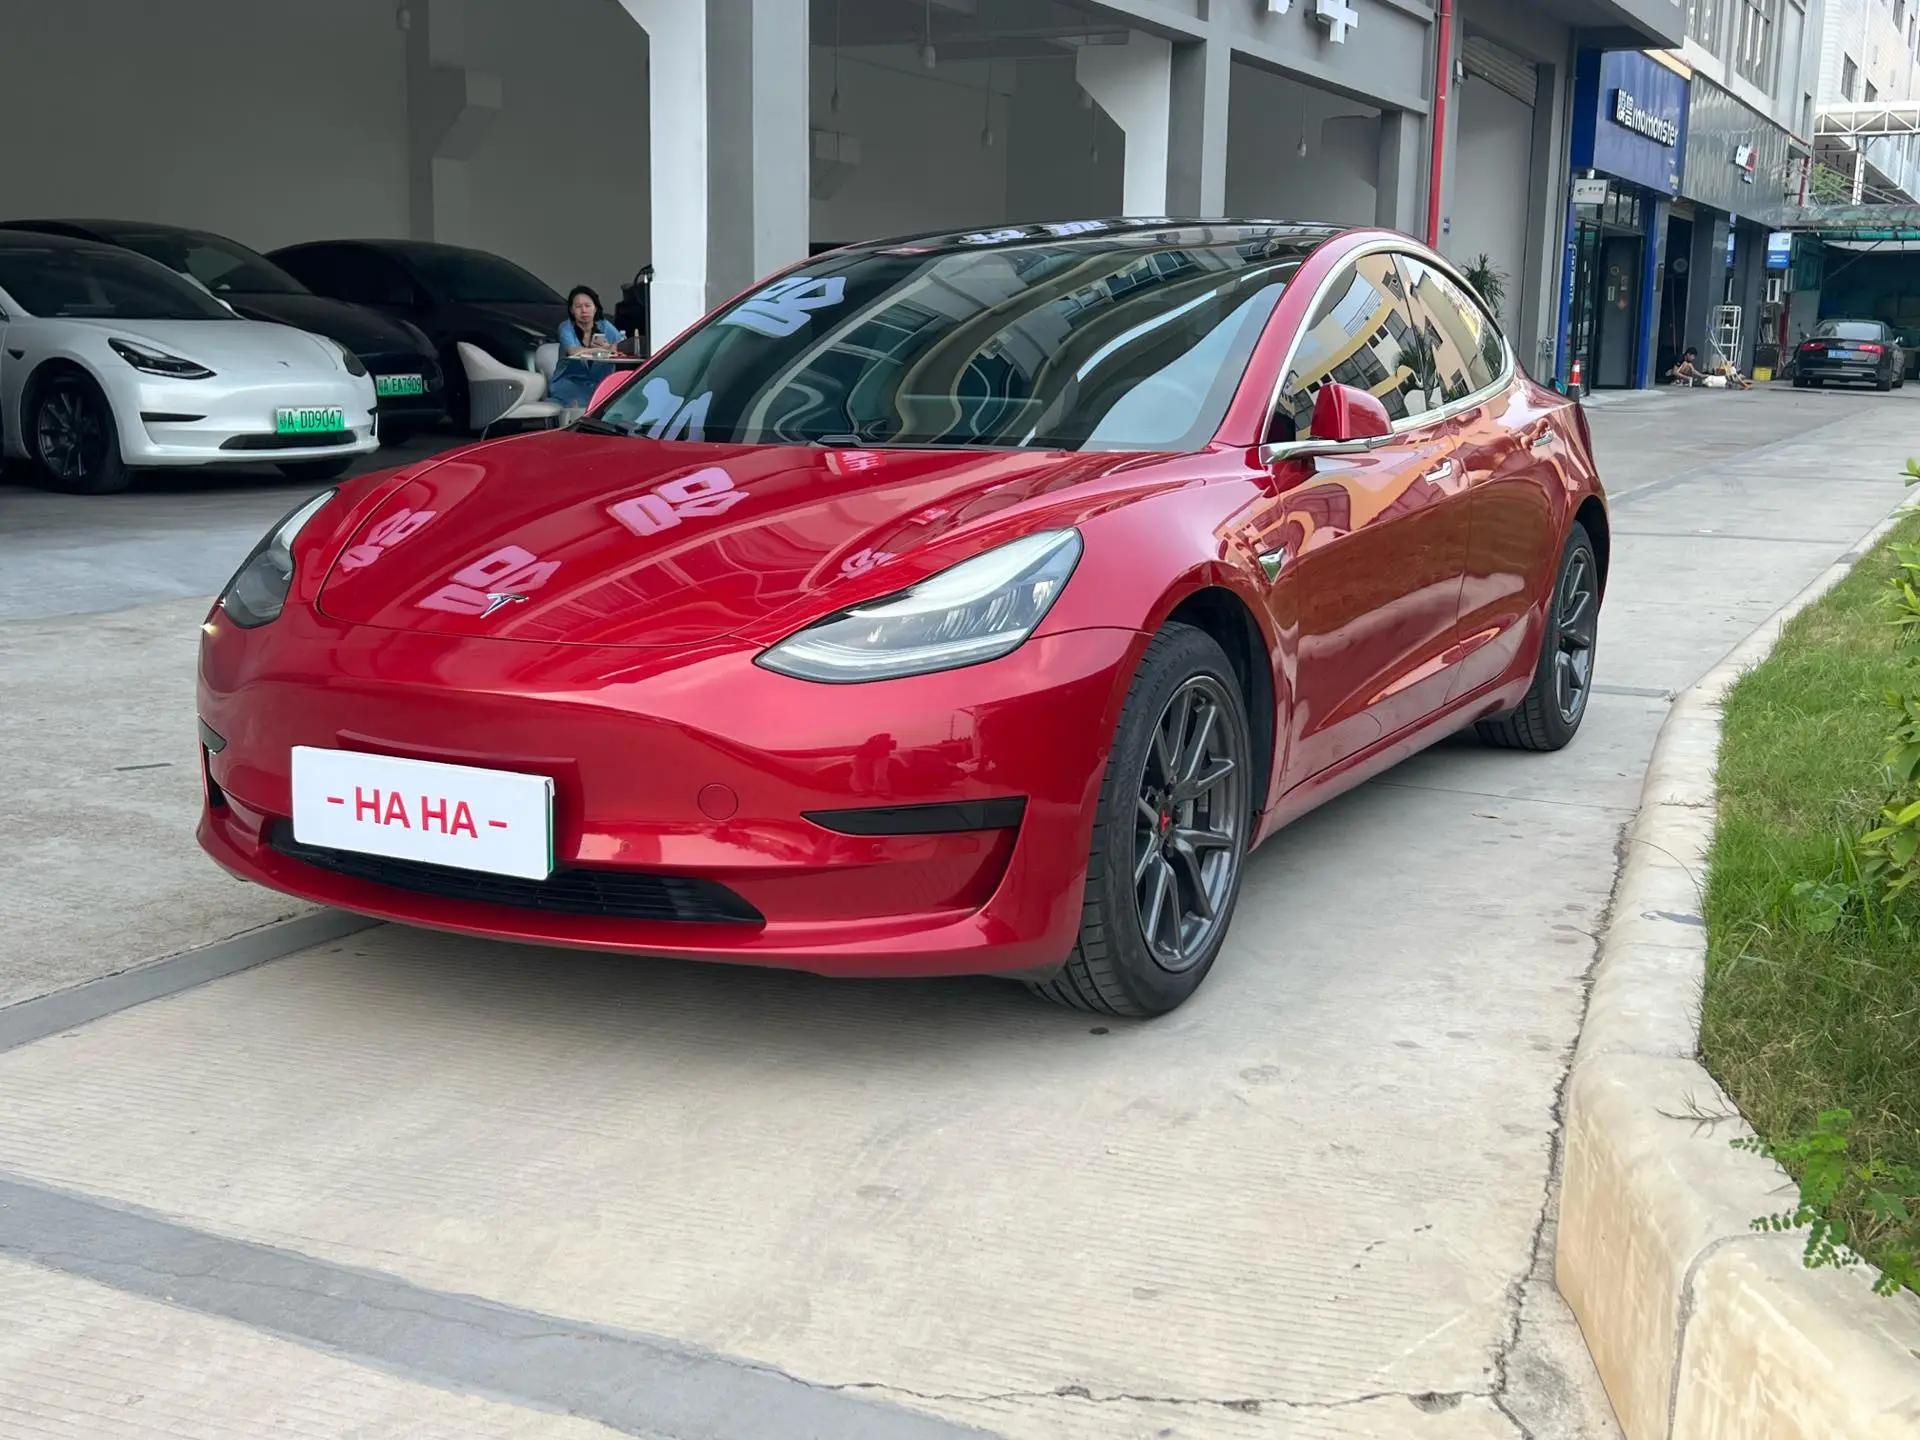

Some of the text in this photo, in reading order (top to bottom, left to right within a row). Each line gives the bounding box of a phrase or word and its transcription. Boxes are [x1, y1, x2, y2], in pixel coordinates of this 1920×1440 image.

[300, 409, 342, 429] DD9047
[355, 786, 411, 829] HA
[421, 795, 478, 838] HA
